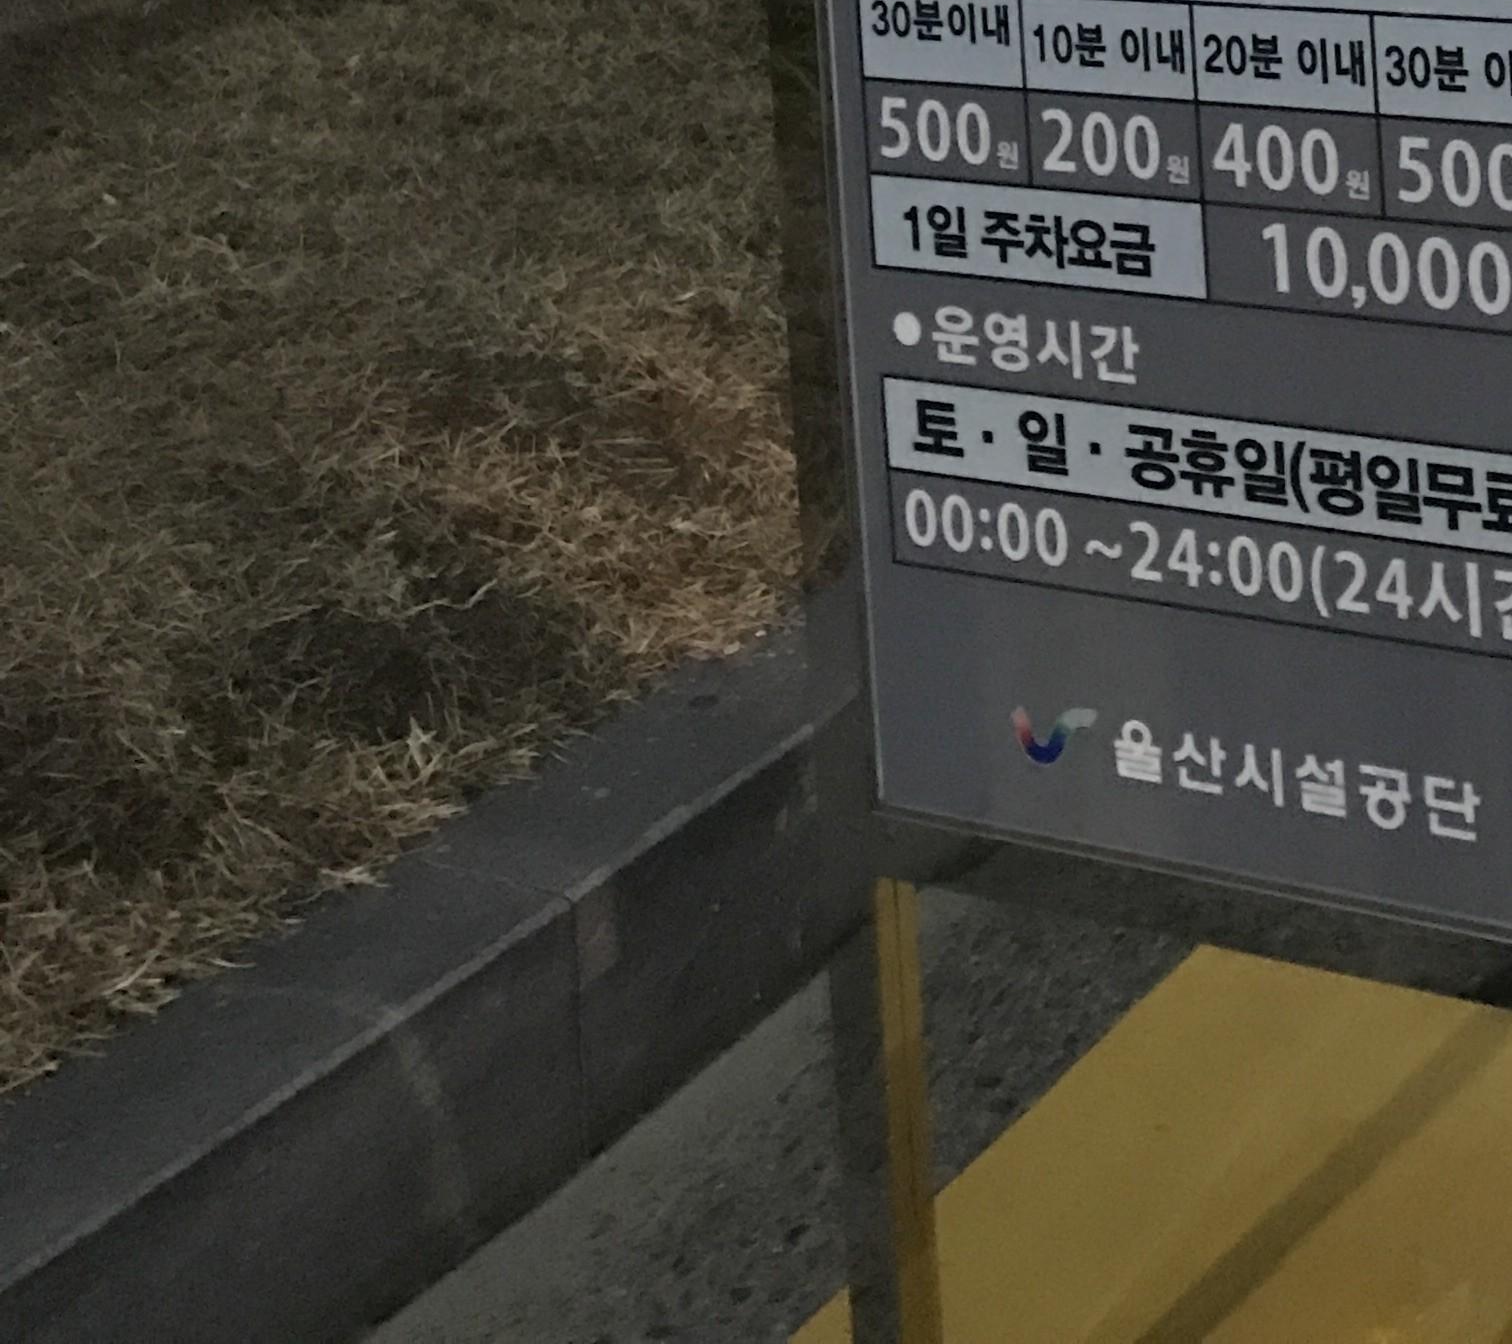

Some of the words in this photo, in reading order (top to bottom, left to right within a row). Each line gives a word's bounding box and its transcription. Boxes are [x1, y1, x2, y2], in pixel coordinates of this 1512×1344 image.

[871, 0, 1012, 47] 30분이내
[1031, 25, 1108, 69] 10분
[1121, 25, 1187, 75] 이내
[1202, 34, 1284, 81] 20분
[1297, 35, 1367, 88] 이내
[1384, 45, 1469, 95] 30분
[979, 208, 1157, 278] 주차요금
[930, 303, 1141, 386] 운영시간
[1112, 717, 1482, 842] 울산시설공단
